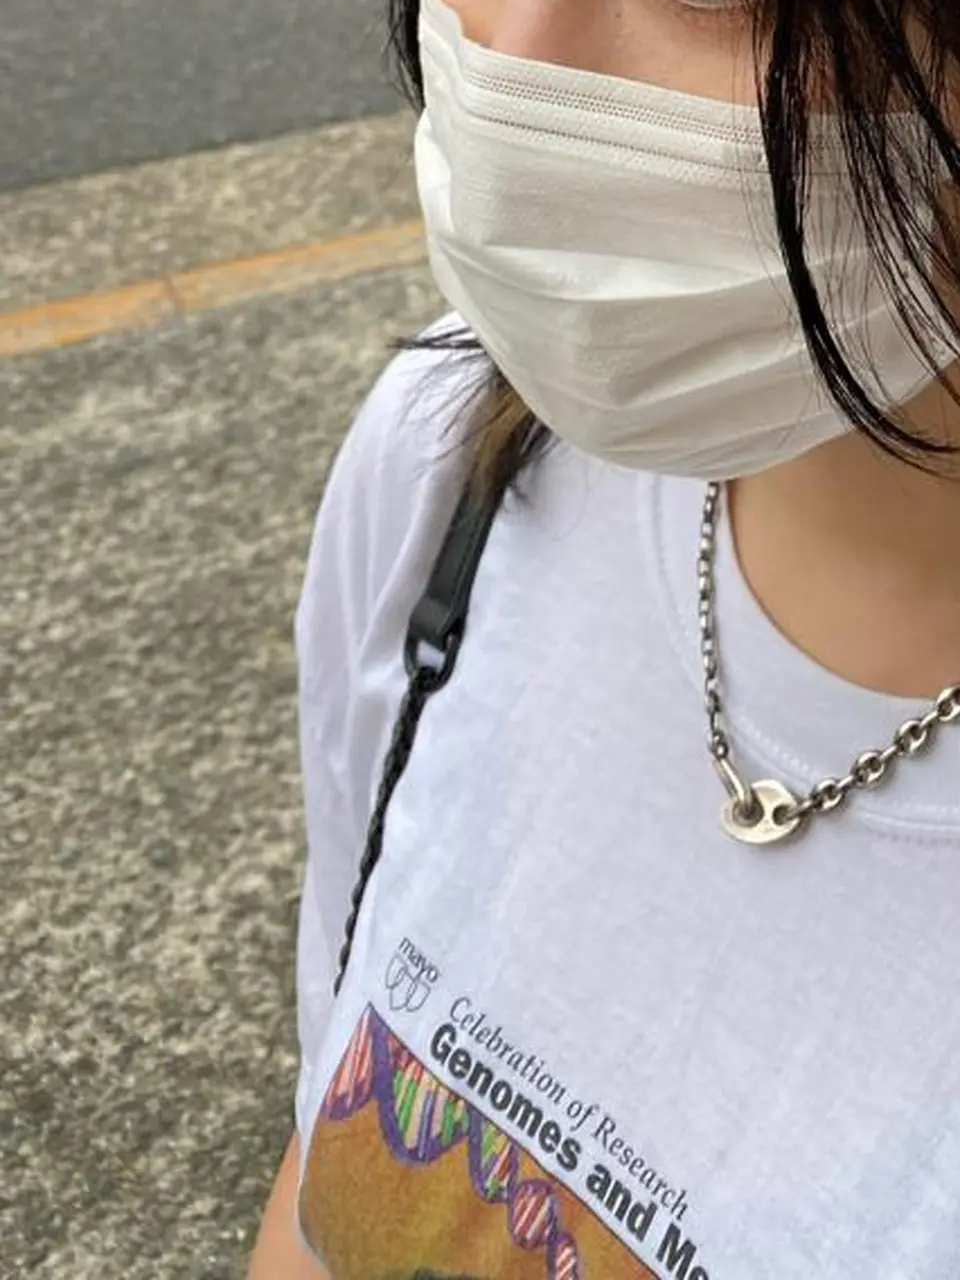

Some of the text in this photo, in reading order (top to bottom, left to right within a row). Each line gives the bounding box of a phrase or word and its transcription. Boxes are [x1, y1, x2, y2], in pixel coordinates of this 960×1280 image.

[399, 936, 440, 984] mayo
[430, 1022, 582, 1171] Genomes
[585, 1163, 659, 1243] and
[450, 996, 689, 1221] Celebration of Research
